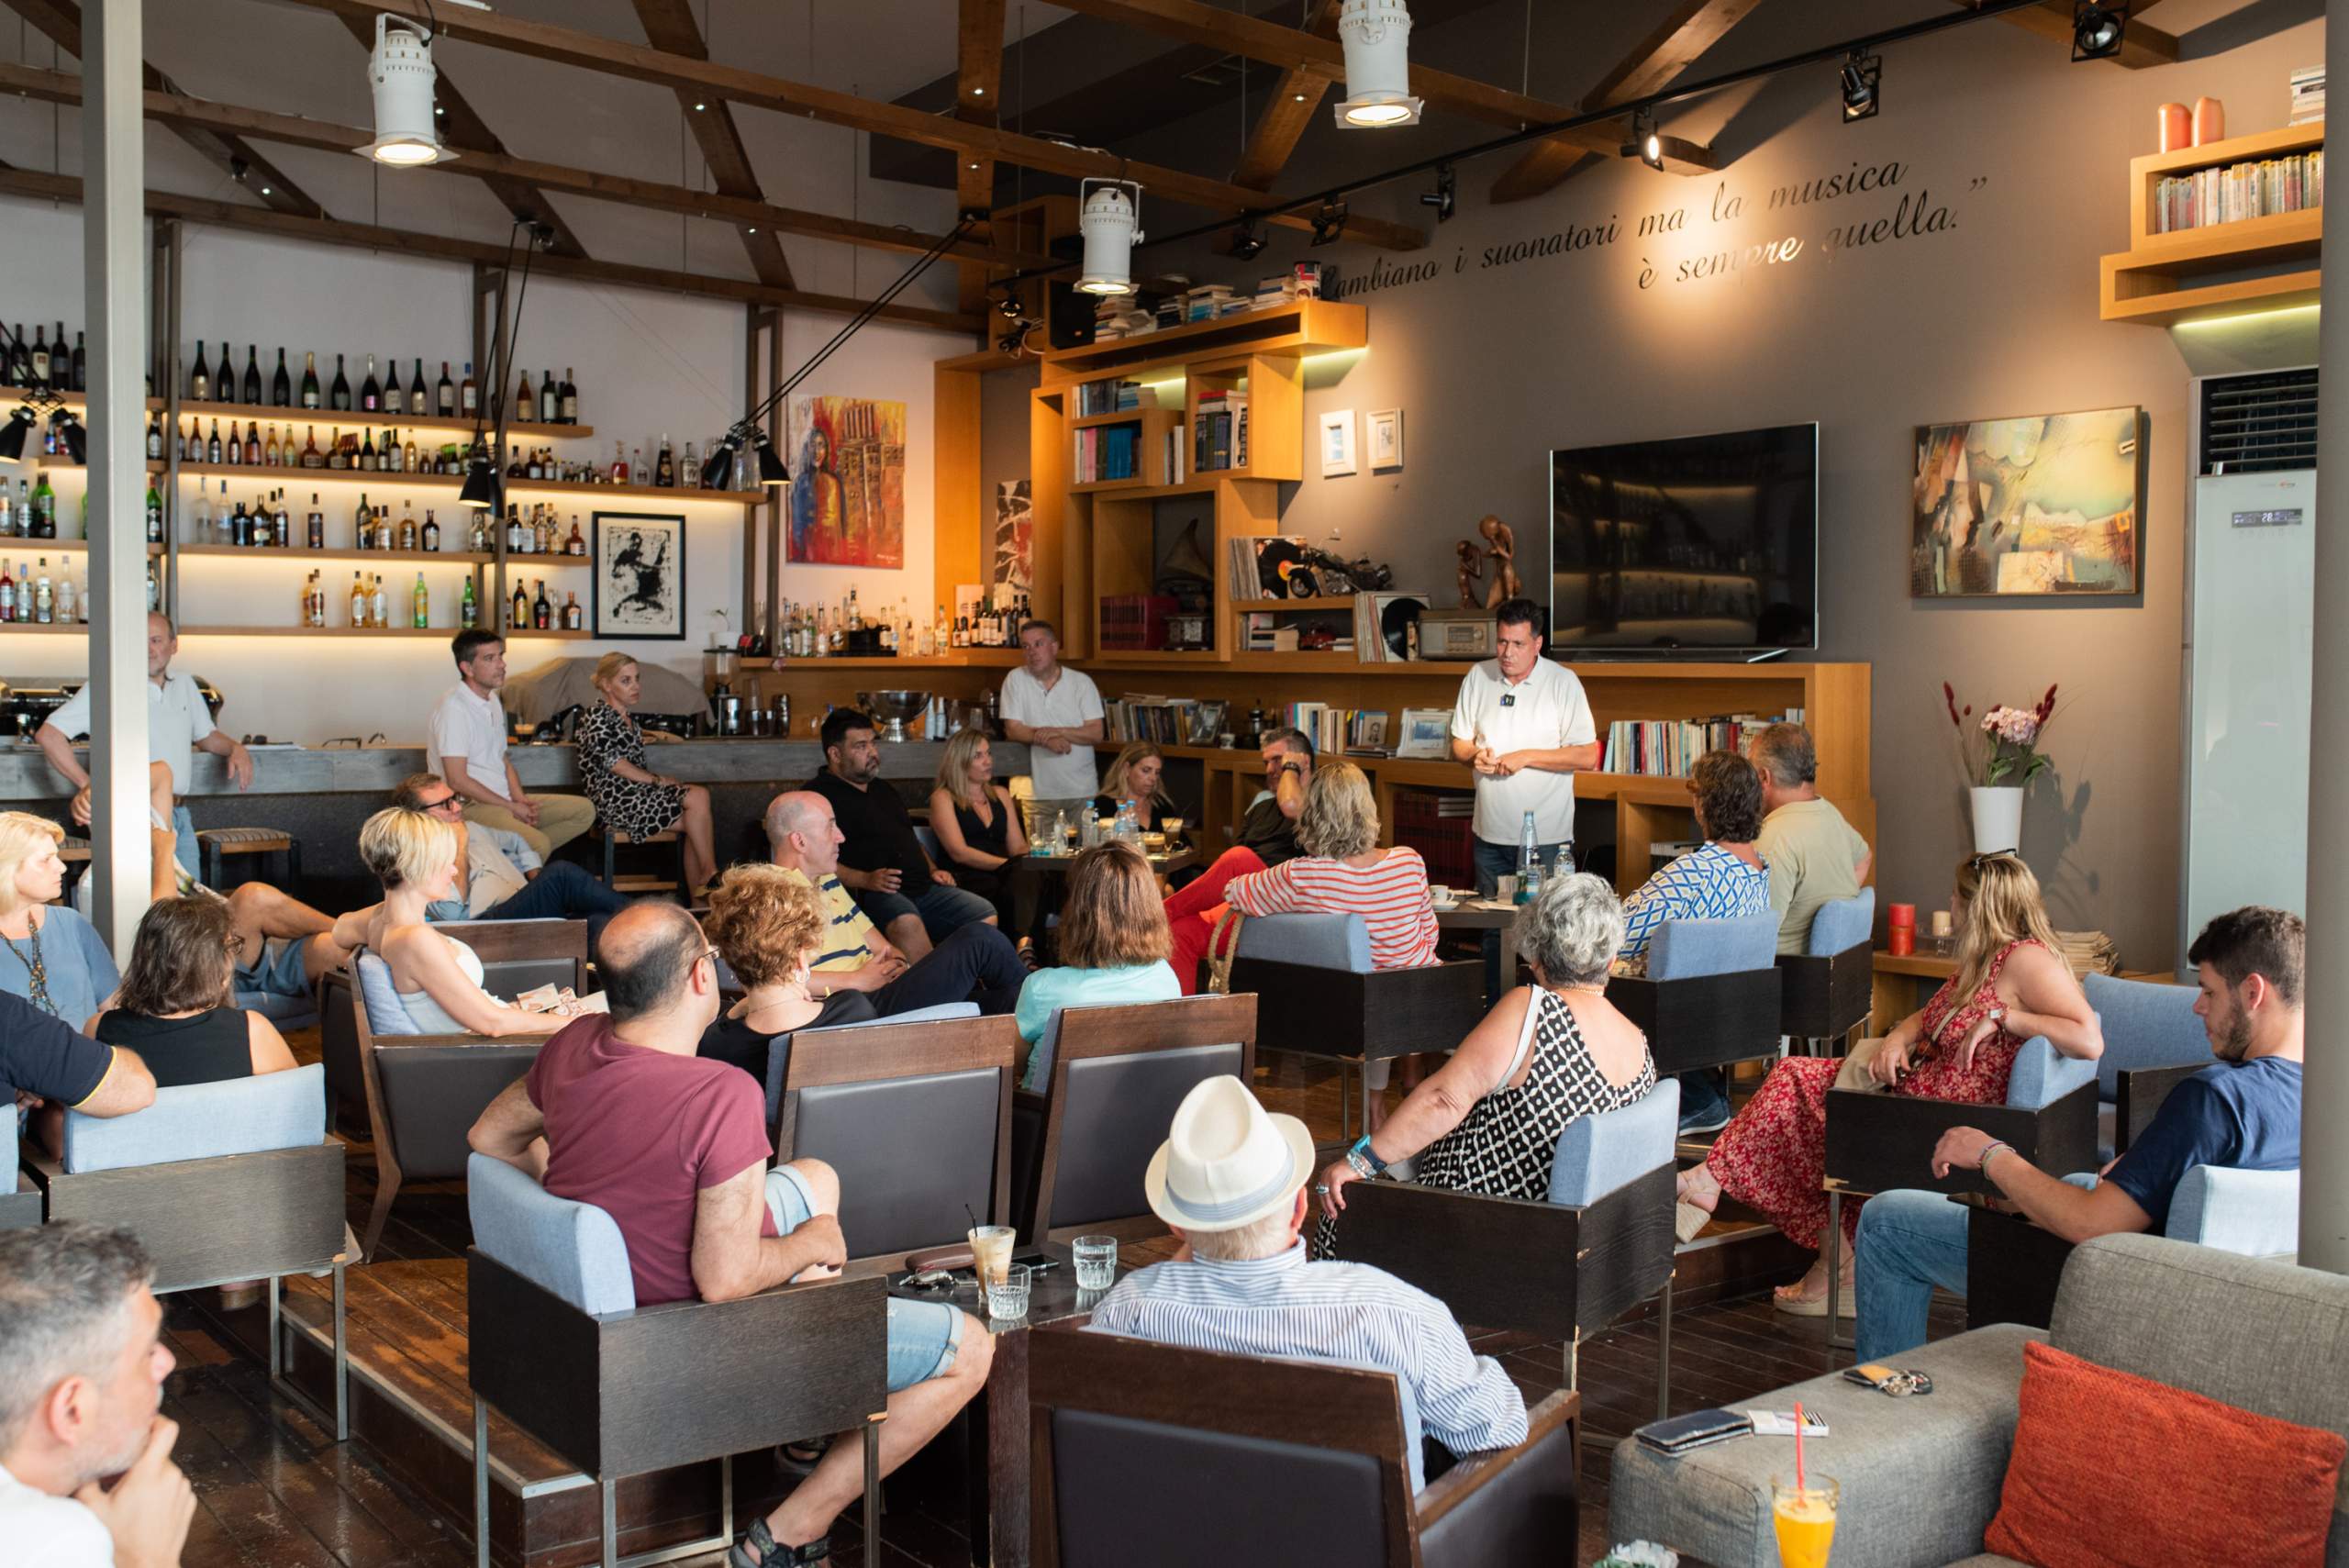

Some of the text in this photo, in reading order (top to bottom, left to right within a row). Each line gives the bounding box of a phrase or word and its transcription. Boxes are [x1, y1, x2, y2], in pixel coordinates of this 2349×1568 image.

[1455, 246, 1470, 274] i
[1481, 214, 1623, 269] suonatori
[1639, 205, 1691, 238] ma
[1711, 181, 1747, 223] la
[1768, 161, 1909, 213] musica
[1638, 257, 1659, 290] è
[1675, 236, 1806, 285] sempre
